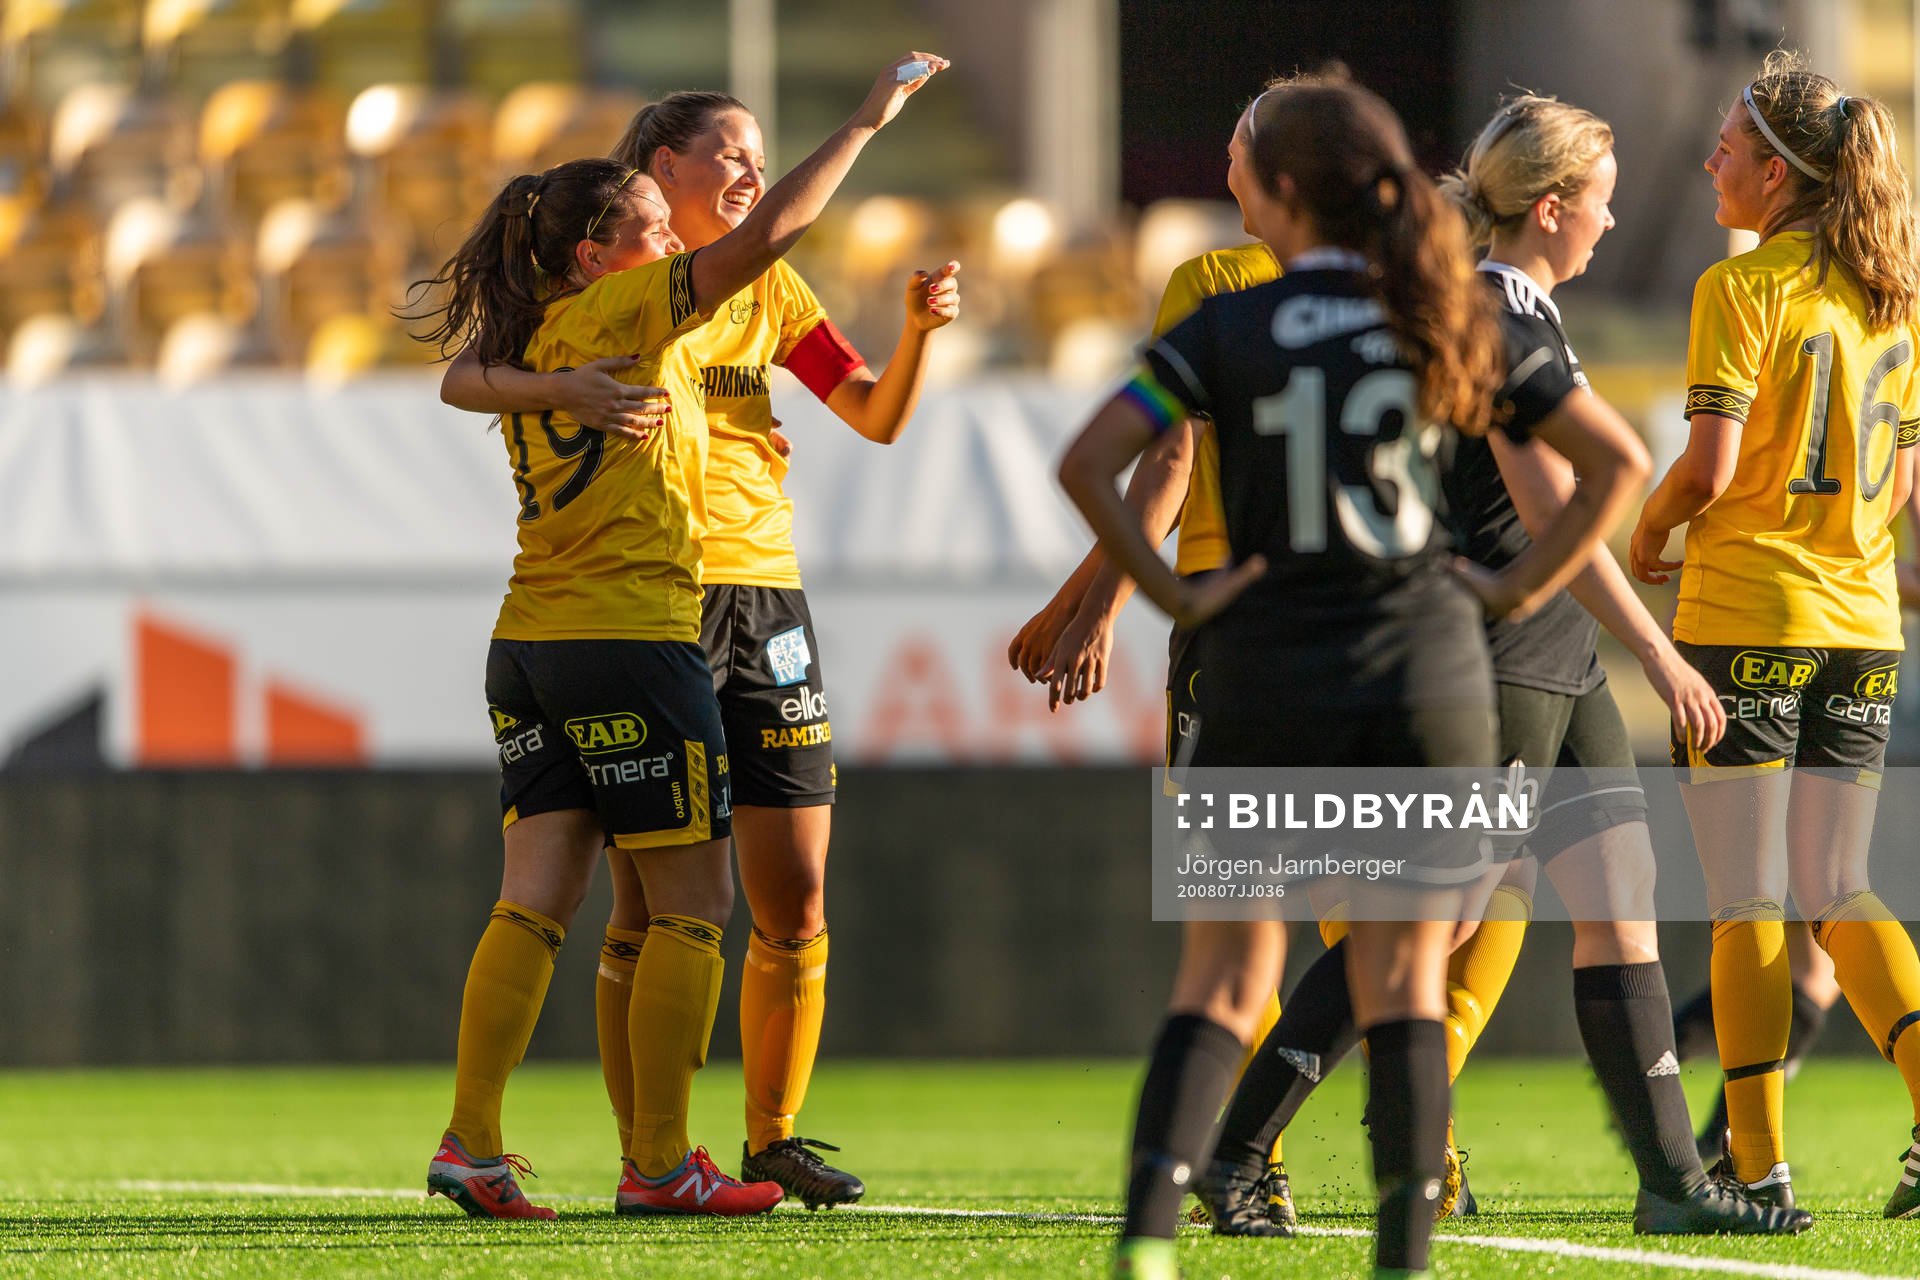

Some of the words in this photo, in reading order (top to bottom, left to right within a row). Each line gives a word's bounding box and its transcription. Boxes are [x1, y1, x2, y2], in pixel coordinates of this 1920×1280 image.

[1789, 332, 1910, 502] 16
[1252, 365, 1440, 559] 13
[1740, 656, 1812, 687] EAB
[568, 718, 639, 748] EAB
[671, 781, 685, 819] umbro
